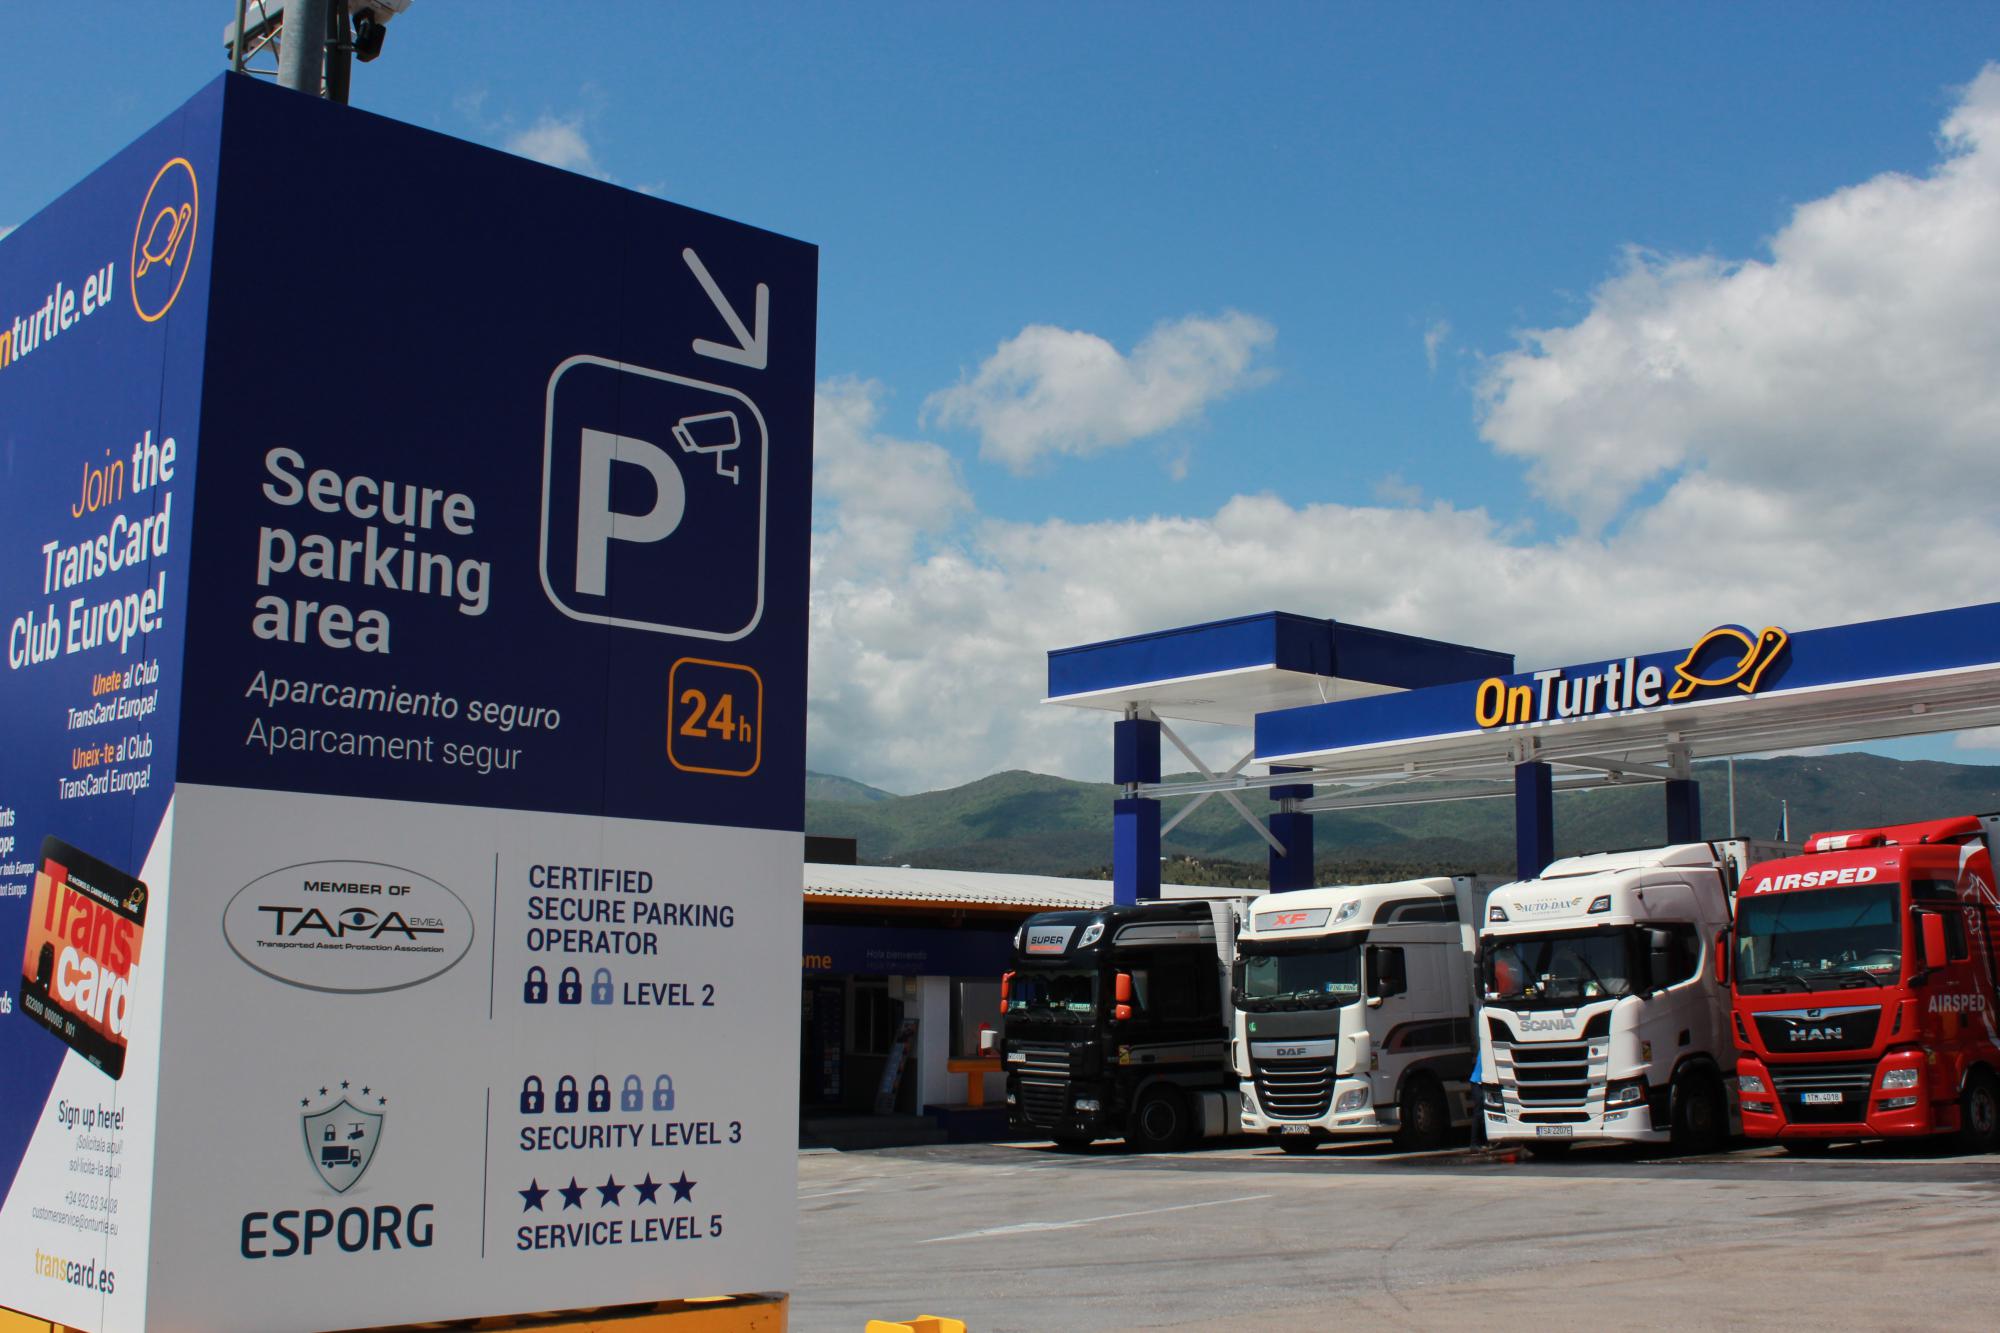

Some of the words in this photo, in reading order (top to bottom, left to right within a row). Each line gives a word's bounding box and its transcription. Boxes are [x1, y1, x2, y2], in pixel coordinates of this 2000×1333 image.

[72, 448, 124, 519] Join
[132, 430, 176, 493] the
[262, 447, 476, 536] Secure
[575, 427, 686, 597] P
[43, 492, 172, 595] TransCard
[256, 525, 491, 617] parking
[9, 604, 60, 670] Club
[66, 571, 166, 654] Europe!
[252, 595, 390, 654] area
[123, 667, 134, 689] al
[135, 658, 159, 685] Club
[68, 697, 116, 731] TransCard
[117, 690, 157, 722] Europa!
[245, 670, 459, 719] Aparcamiento
[467, 699, 561, 732] seguro
[1475, 657, 1662, 728] OnTurtle
[680, 688, 752, 743] 24h
[72, 742, 114, 771] Uneix-te
[116, 740, 127, 762] al
[128, 733, 153, 759] Club
[246, 718, 435, 762] Aparcament
[443, 743, 523, 775] segur
[59, 769, 109, 800] TransCard
[110, 765, 150, 796] Europa!
[304, 881, 382, 895] MEMBER
[388, 885, 411, 896] OF
[528, 864, 653, 894] CERTIFIED
[1754, 866, 1877, 895] AIRSPED
[43, 857, 134, 975] Trans
[258, 905, 417, 941] TAPA
[410, 917, 444, 927] EMEA
[527, 896, 626, 923] SECURE
[633, 901, 734, 928] PARKING
[1273, 912, 1309, 926] XF
[256, 940, 315, 950] Transported
[316, 942, 343, 950] Asset
[346, 943, 392, 951] Protection
[394, 944, 444, 953] Association
[526, 927, 658, 955] OPERATOR
[1030, 935, 1064, 945] SUPER
[57, 945, 138, 1040] card
[623, 982, 695, 1006] LEVEL
[701, 983, 715, 1006] 2
[1928, 993, 1985, 1013] AIRSPED
[1519, 1019, 1575, 1033] SCANIA
[1789, 1027, 1842, 1041] MAN
[1276, 1048, 1307, 1057] DAF
[58, 1099, 80, 1131] Sign
[82, 1109, 94, 1133] up
[98, 1102, 124, 1131] here!
[519, 1123, 644, 1151] SECURITY
[651, 1121, 722, 1146] LEVEL
[728, 1121, 742, 1144] 3
[240, 1203, 434, 1259] ESPORG
[516, 1220, 623, 1251] SERVICE
[630, 1216, 702, 1243] LEVEL
[709, 1214, 723, 1238] 5
[35, 1247, 115, 1294] transcard.es
